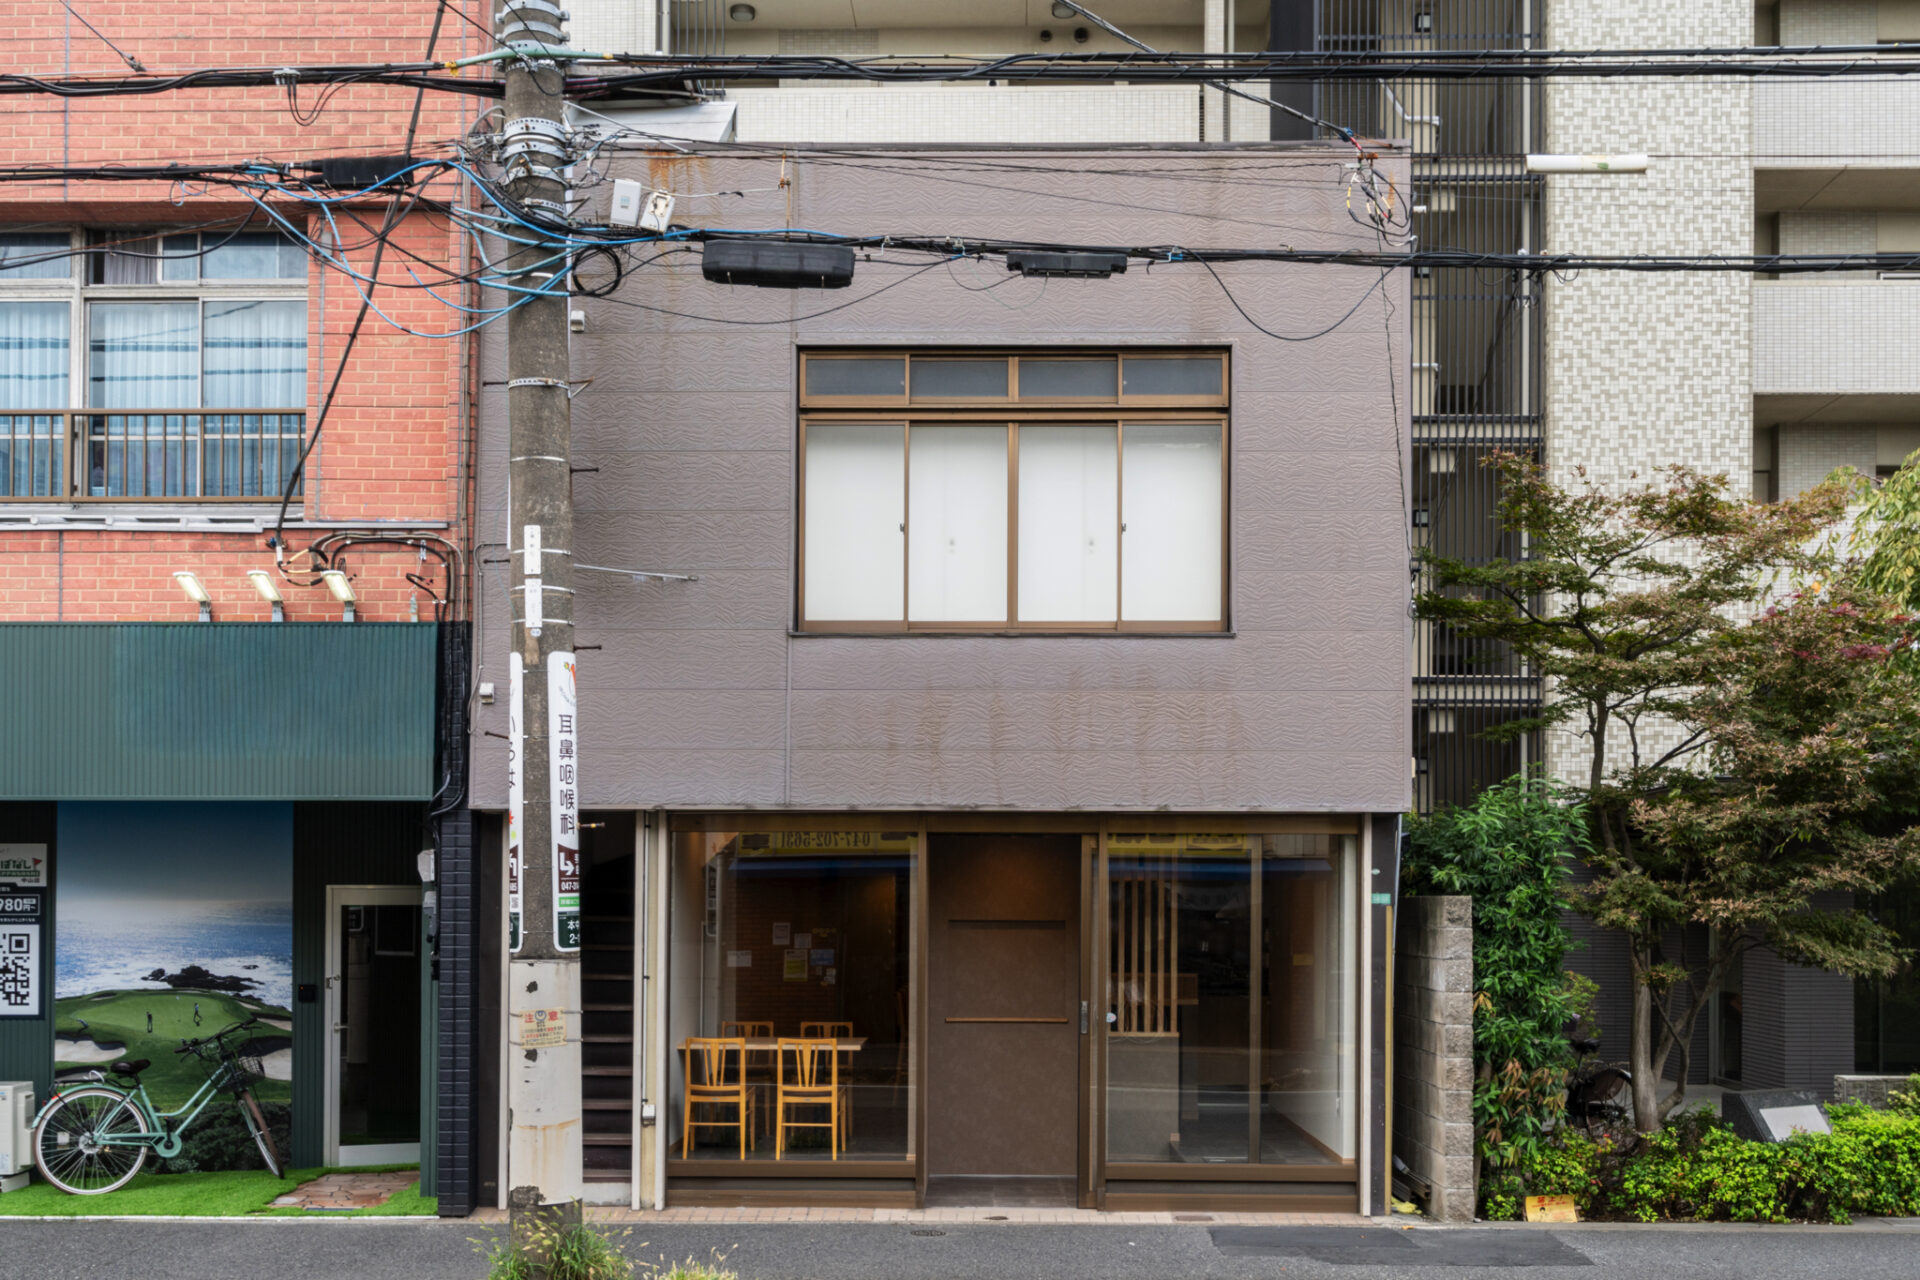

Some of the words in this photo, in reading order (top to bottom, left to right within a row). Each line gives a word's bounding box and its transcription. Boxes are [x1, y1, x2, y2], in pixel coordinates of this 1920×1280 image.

[558, 713, 577, 836] 耳鼻咽喉科
